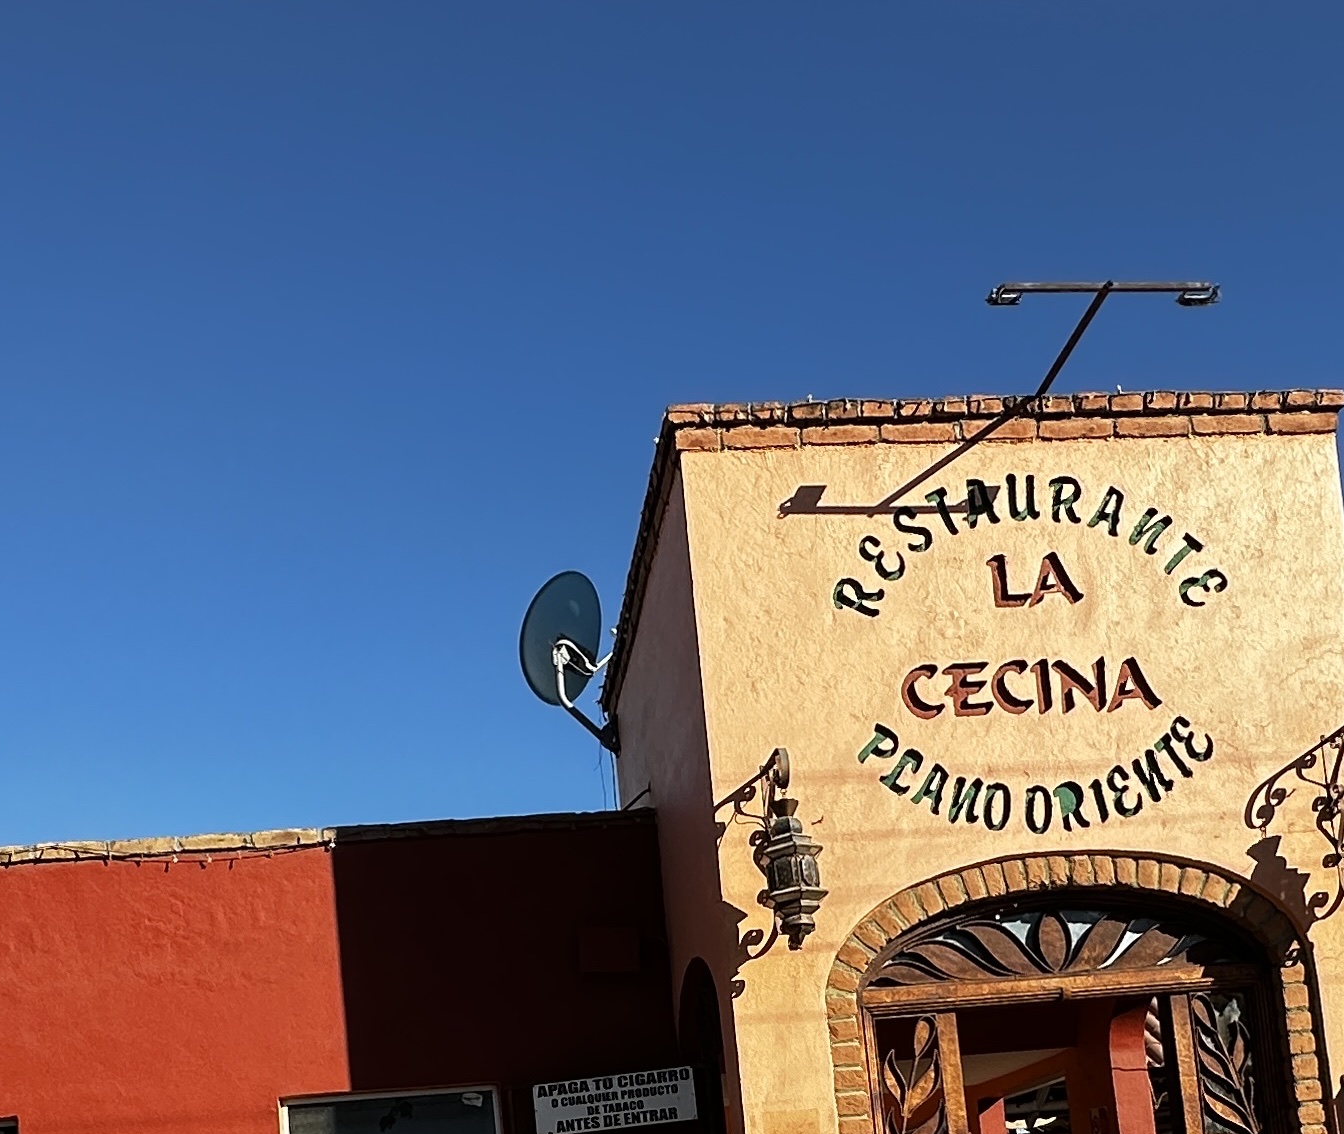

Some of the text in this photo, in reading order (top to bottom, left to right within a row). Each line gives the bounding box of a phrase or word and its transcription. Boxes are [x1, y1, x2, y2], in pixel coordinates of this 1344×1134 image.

[833, 473, 1228, 618] RESTAURANTE
[986, 551, 1084, 608] LA
[901, 656, 1162, 720] CECINA
[1025, 716, 1214, 834] ORIENTE
[537, 1068, 690, 1098] APAGA TU CIGARRO
[551, 1083, 679, 1108] O CUALQUIER PRODUCTO
[556, 1107, 678, 1134] ANTES DE ENTRAR
[587, 1100, 645, 1116] DE TABACO
